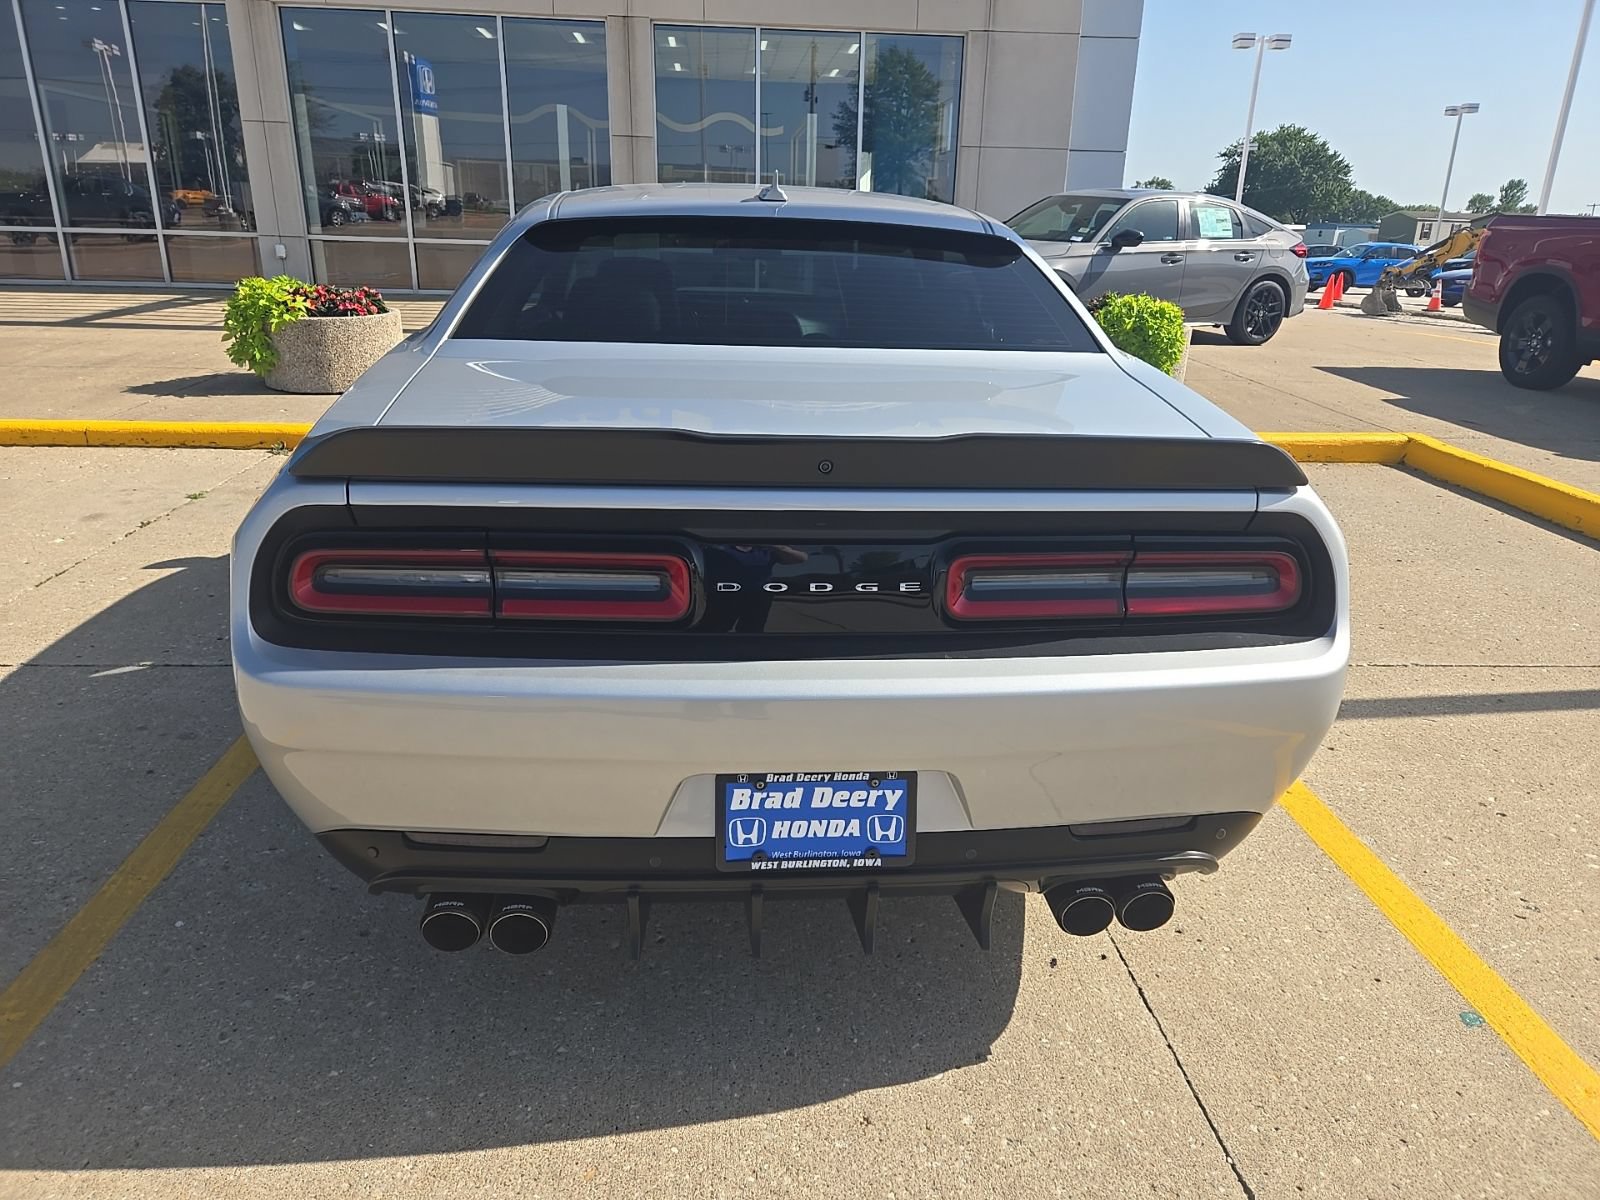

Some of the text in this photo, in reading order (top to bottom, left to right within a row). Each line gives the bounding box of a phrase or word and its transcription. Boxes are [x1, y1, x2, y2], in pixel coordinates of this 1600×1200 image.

[717, 582, 921, 592] DODGE
[766, 772, 870, 783] Brad Deery Honda
[730, 787, 903, 811] Brad Deery
[771, 819, 860, 839] HONDA
[771, 850, 792, 858] West
[841, 850, 861, 858] Iowa
[751, 858, 882, 870] WEST BURLINGTON, IOWA
